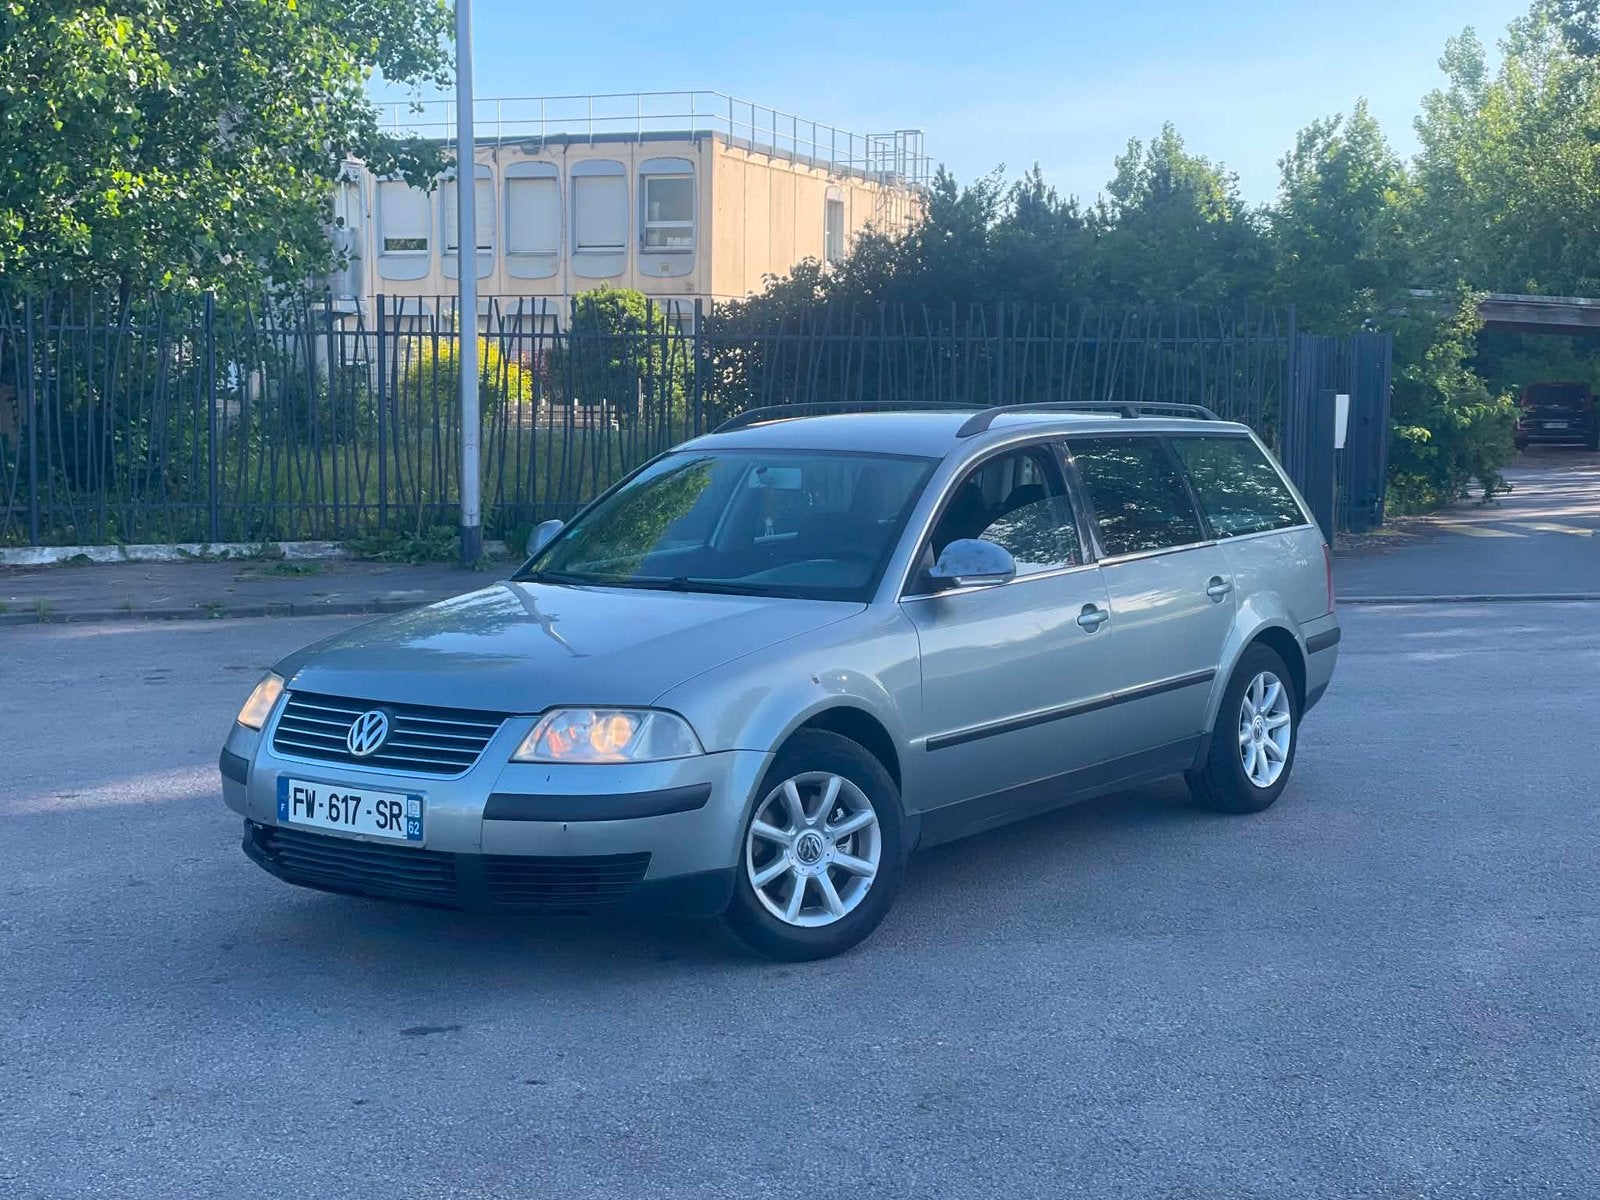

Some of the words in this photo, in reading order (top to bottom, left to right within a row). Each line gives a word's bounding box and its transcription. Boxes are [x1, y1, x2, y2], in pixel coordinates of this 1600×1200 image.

[347, 711, 388, 756] VW
[280, 803, 285, 812] F
[293, 787, 403, 832] FW-617-SR
[408, 821, 420, 835] 62
